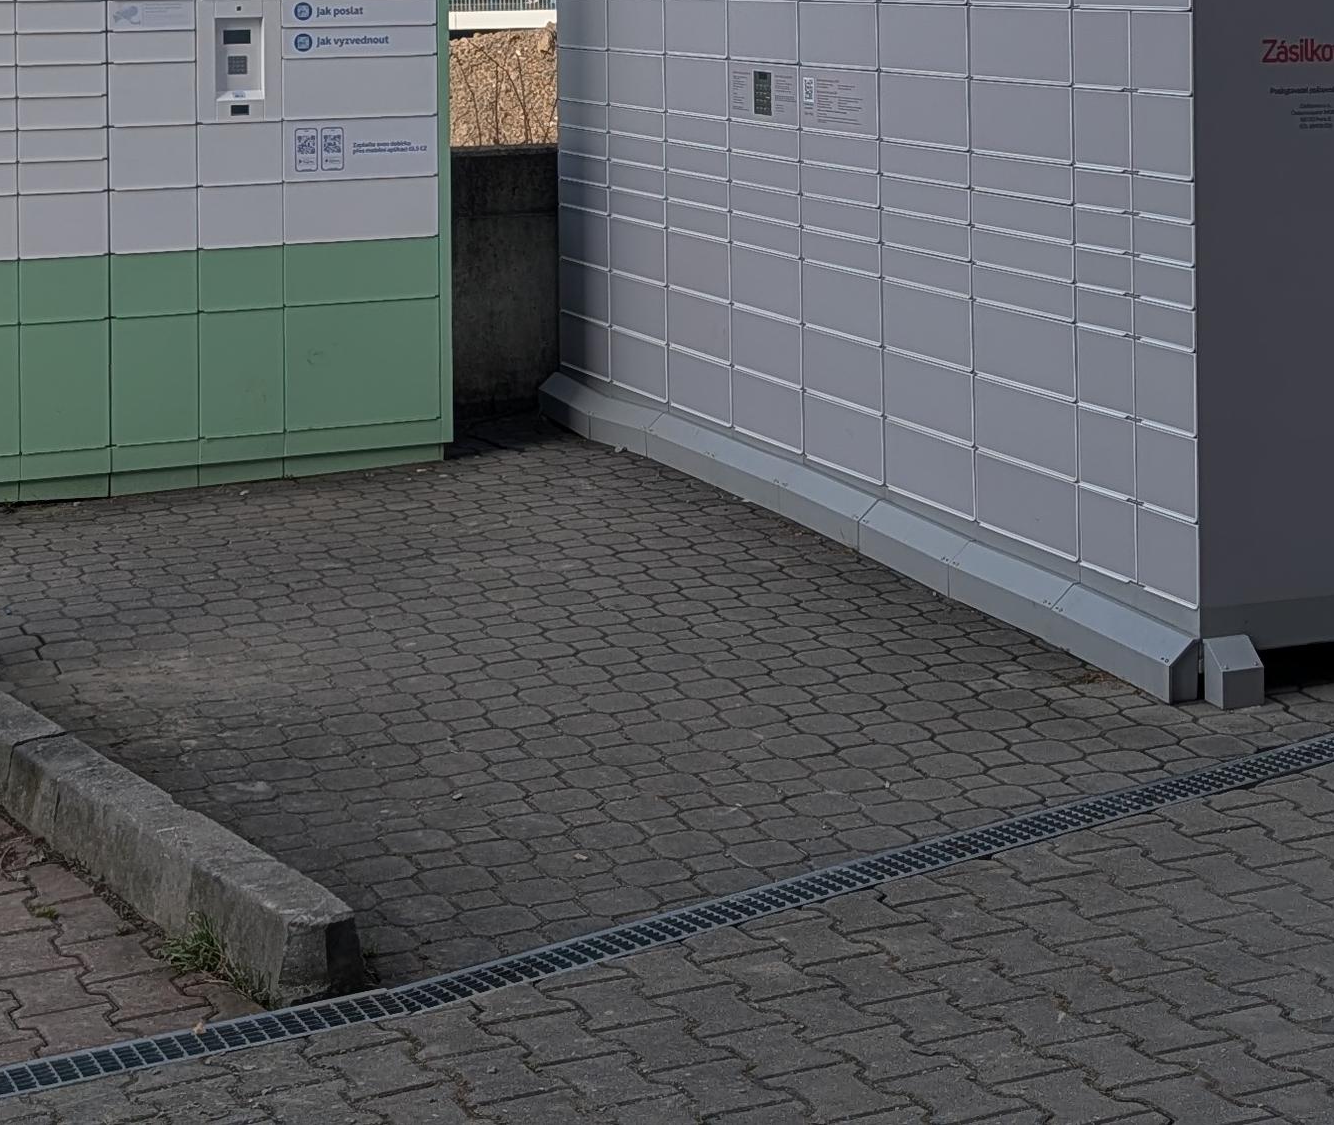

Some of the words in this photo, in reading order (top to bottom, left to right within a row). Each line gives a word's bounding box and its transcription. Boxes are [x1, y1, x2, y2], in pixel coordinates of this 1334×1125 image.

[316, 7, 332, 18] Jak
[333, 6, 363, 17] poslat
[316, 36, 332, 48] Jak
[333, 35, 389, 47] vyzvednout
